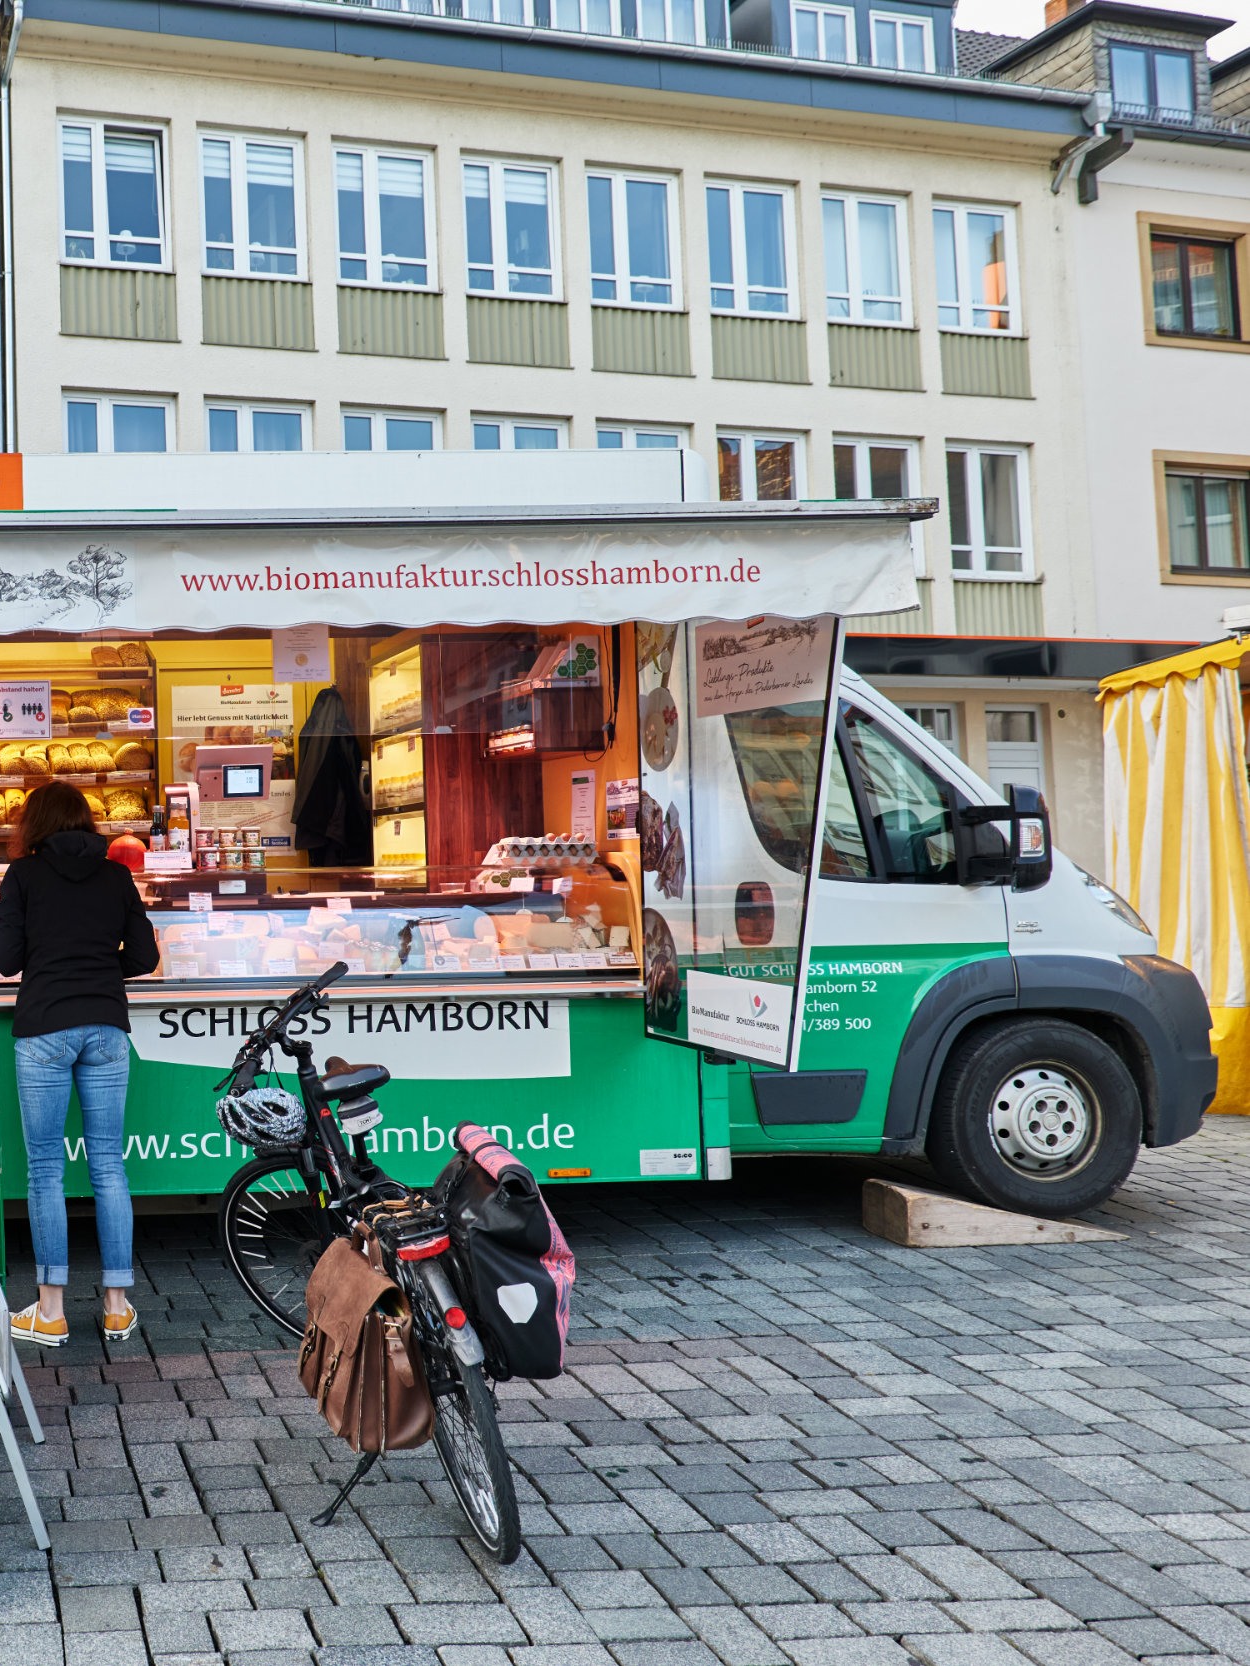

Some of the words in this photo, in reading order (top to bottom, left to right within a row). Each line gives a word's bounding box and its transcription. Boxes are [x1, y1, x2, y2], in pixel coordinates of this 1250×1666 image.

[180, 557, 762, 593] www.biomanufaktur.schlosshamborn.de
[245, 713, 289, 721] Natürlichkeit
[830, 961, 903, 975] HAMBORN
[806, 981, 857, 994] amborn
[862, 980, 878, 993] 52
[348, 1000, 551, 1034] HAMBORN
[691, 1006, 730, 1021] BioManufaktur
[736, 1017, 756, 1027] SCHLOSS
[756, 1022, 780, 1032] HAMBORN
[802, 1018, 840, 1032] 1/389
[845, 1018, 871, 1030] 500
